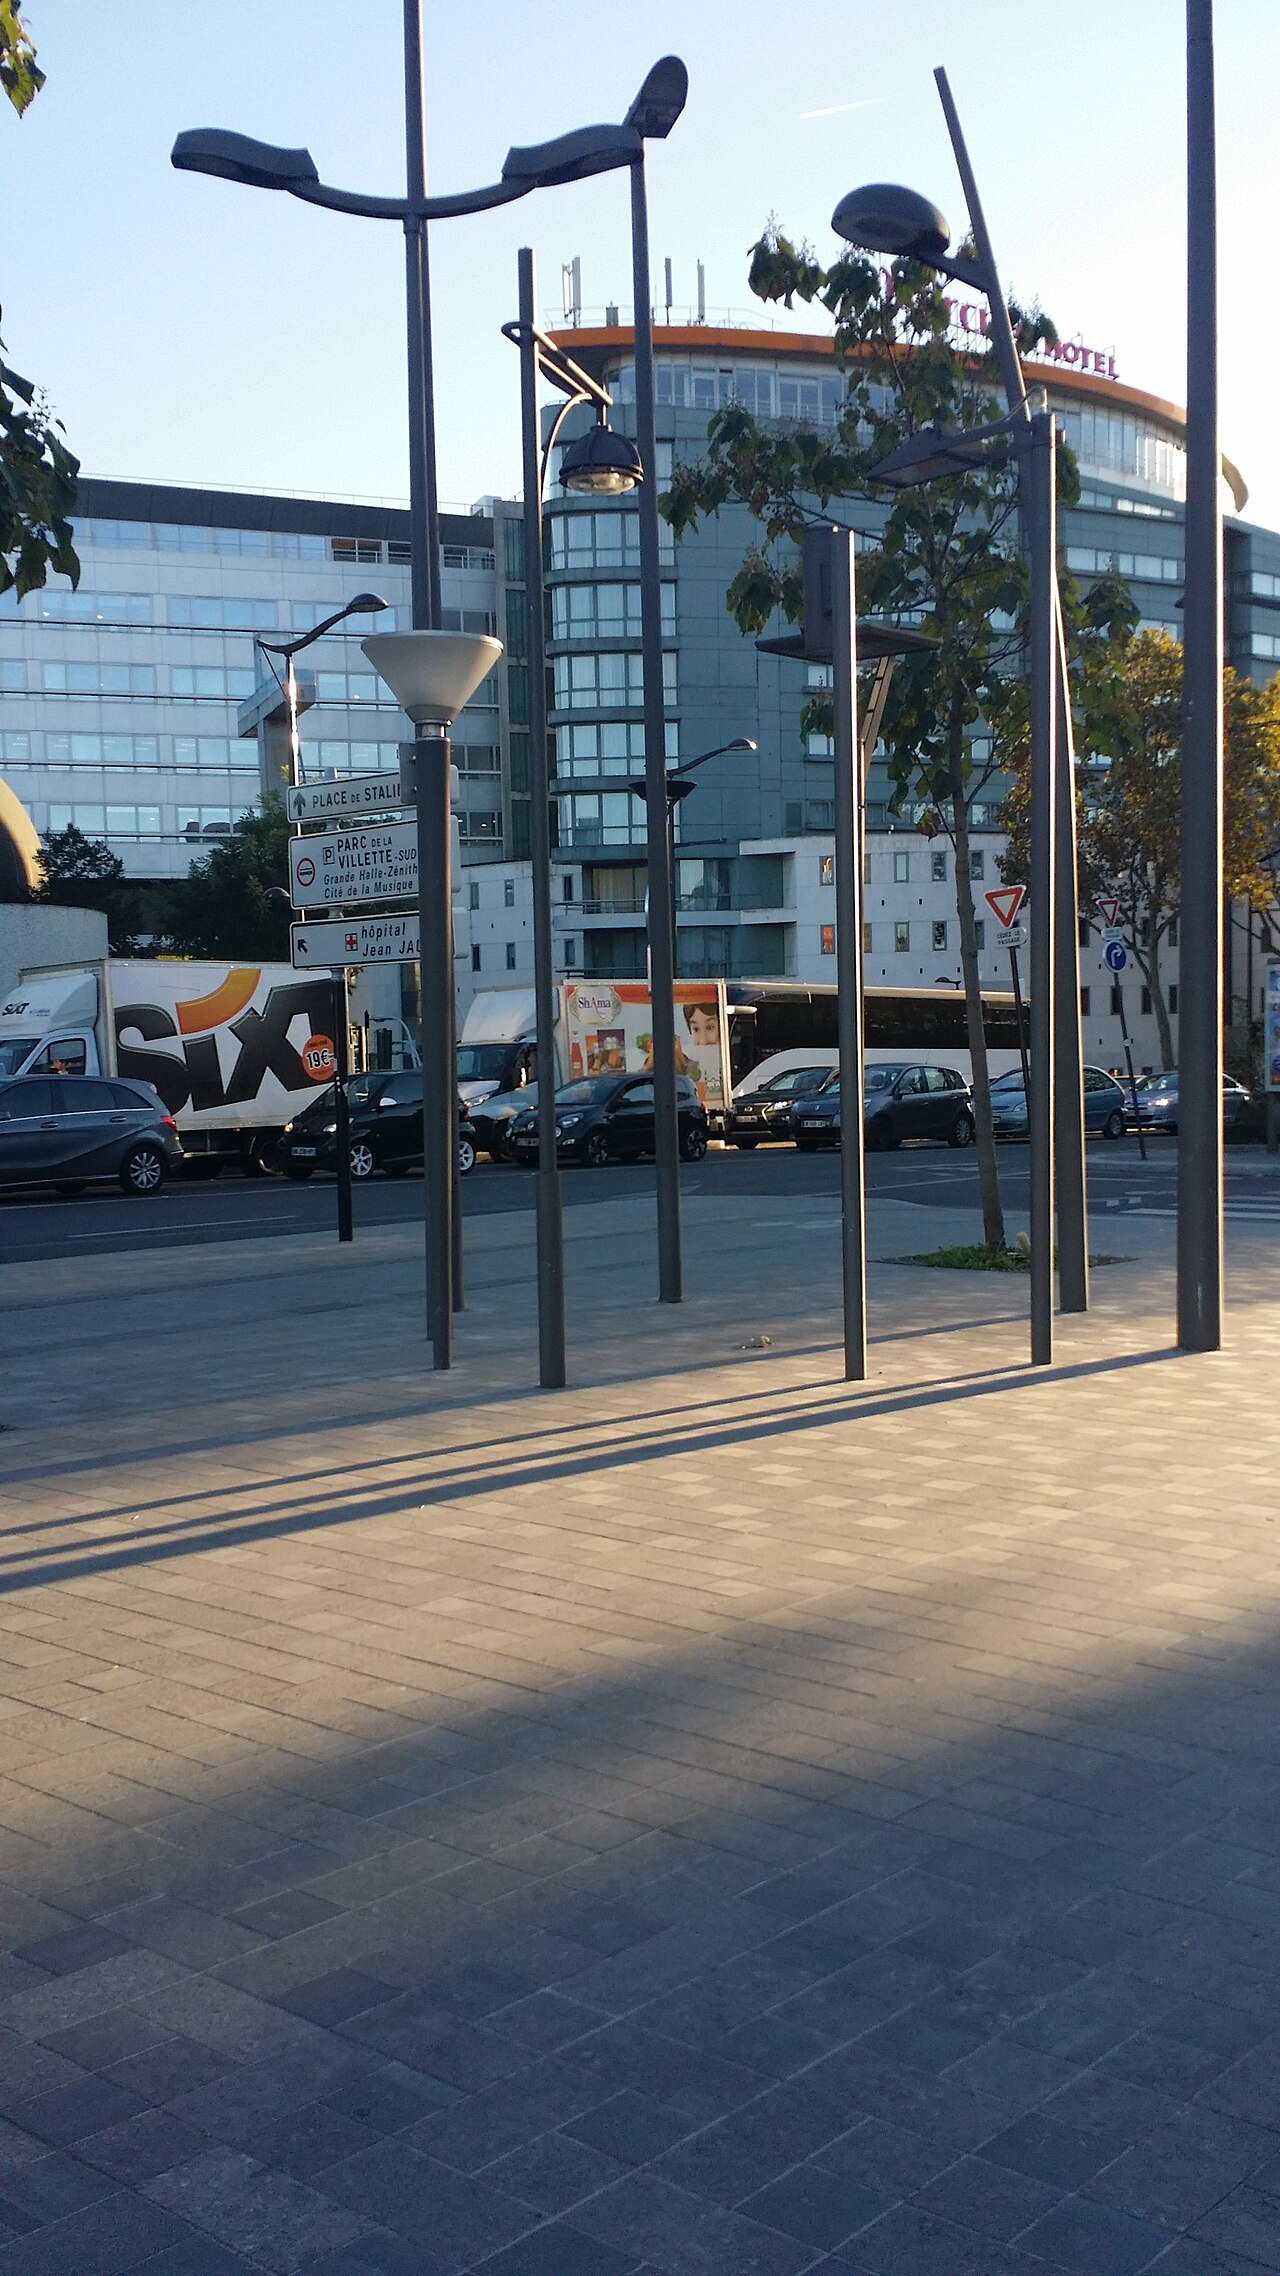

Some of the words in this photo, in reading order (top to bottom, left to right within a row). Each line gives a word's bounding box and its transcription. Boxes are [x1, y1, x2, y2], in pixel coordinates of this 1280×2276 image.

[1044, 339, 1120, 381] HOTEL
[312, 791, 347, 808] PLACE
[351, 793, 361, 803] DE
[337, 836, 367, 852] PARC
[371, 838, 381, 848] DE
[383, 836, 393, 846] LA
[324, 871, 355, 885] Grande
[324, 886, 343, 899] Cité
[347, 885, 358, 896] de
[361, 883, 370, 894] la
[374, 880, 413, 893] Musique
[361, 922, 406, 941] hôpital
[362, 943, 392, 957] Jean
